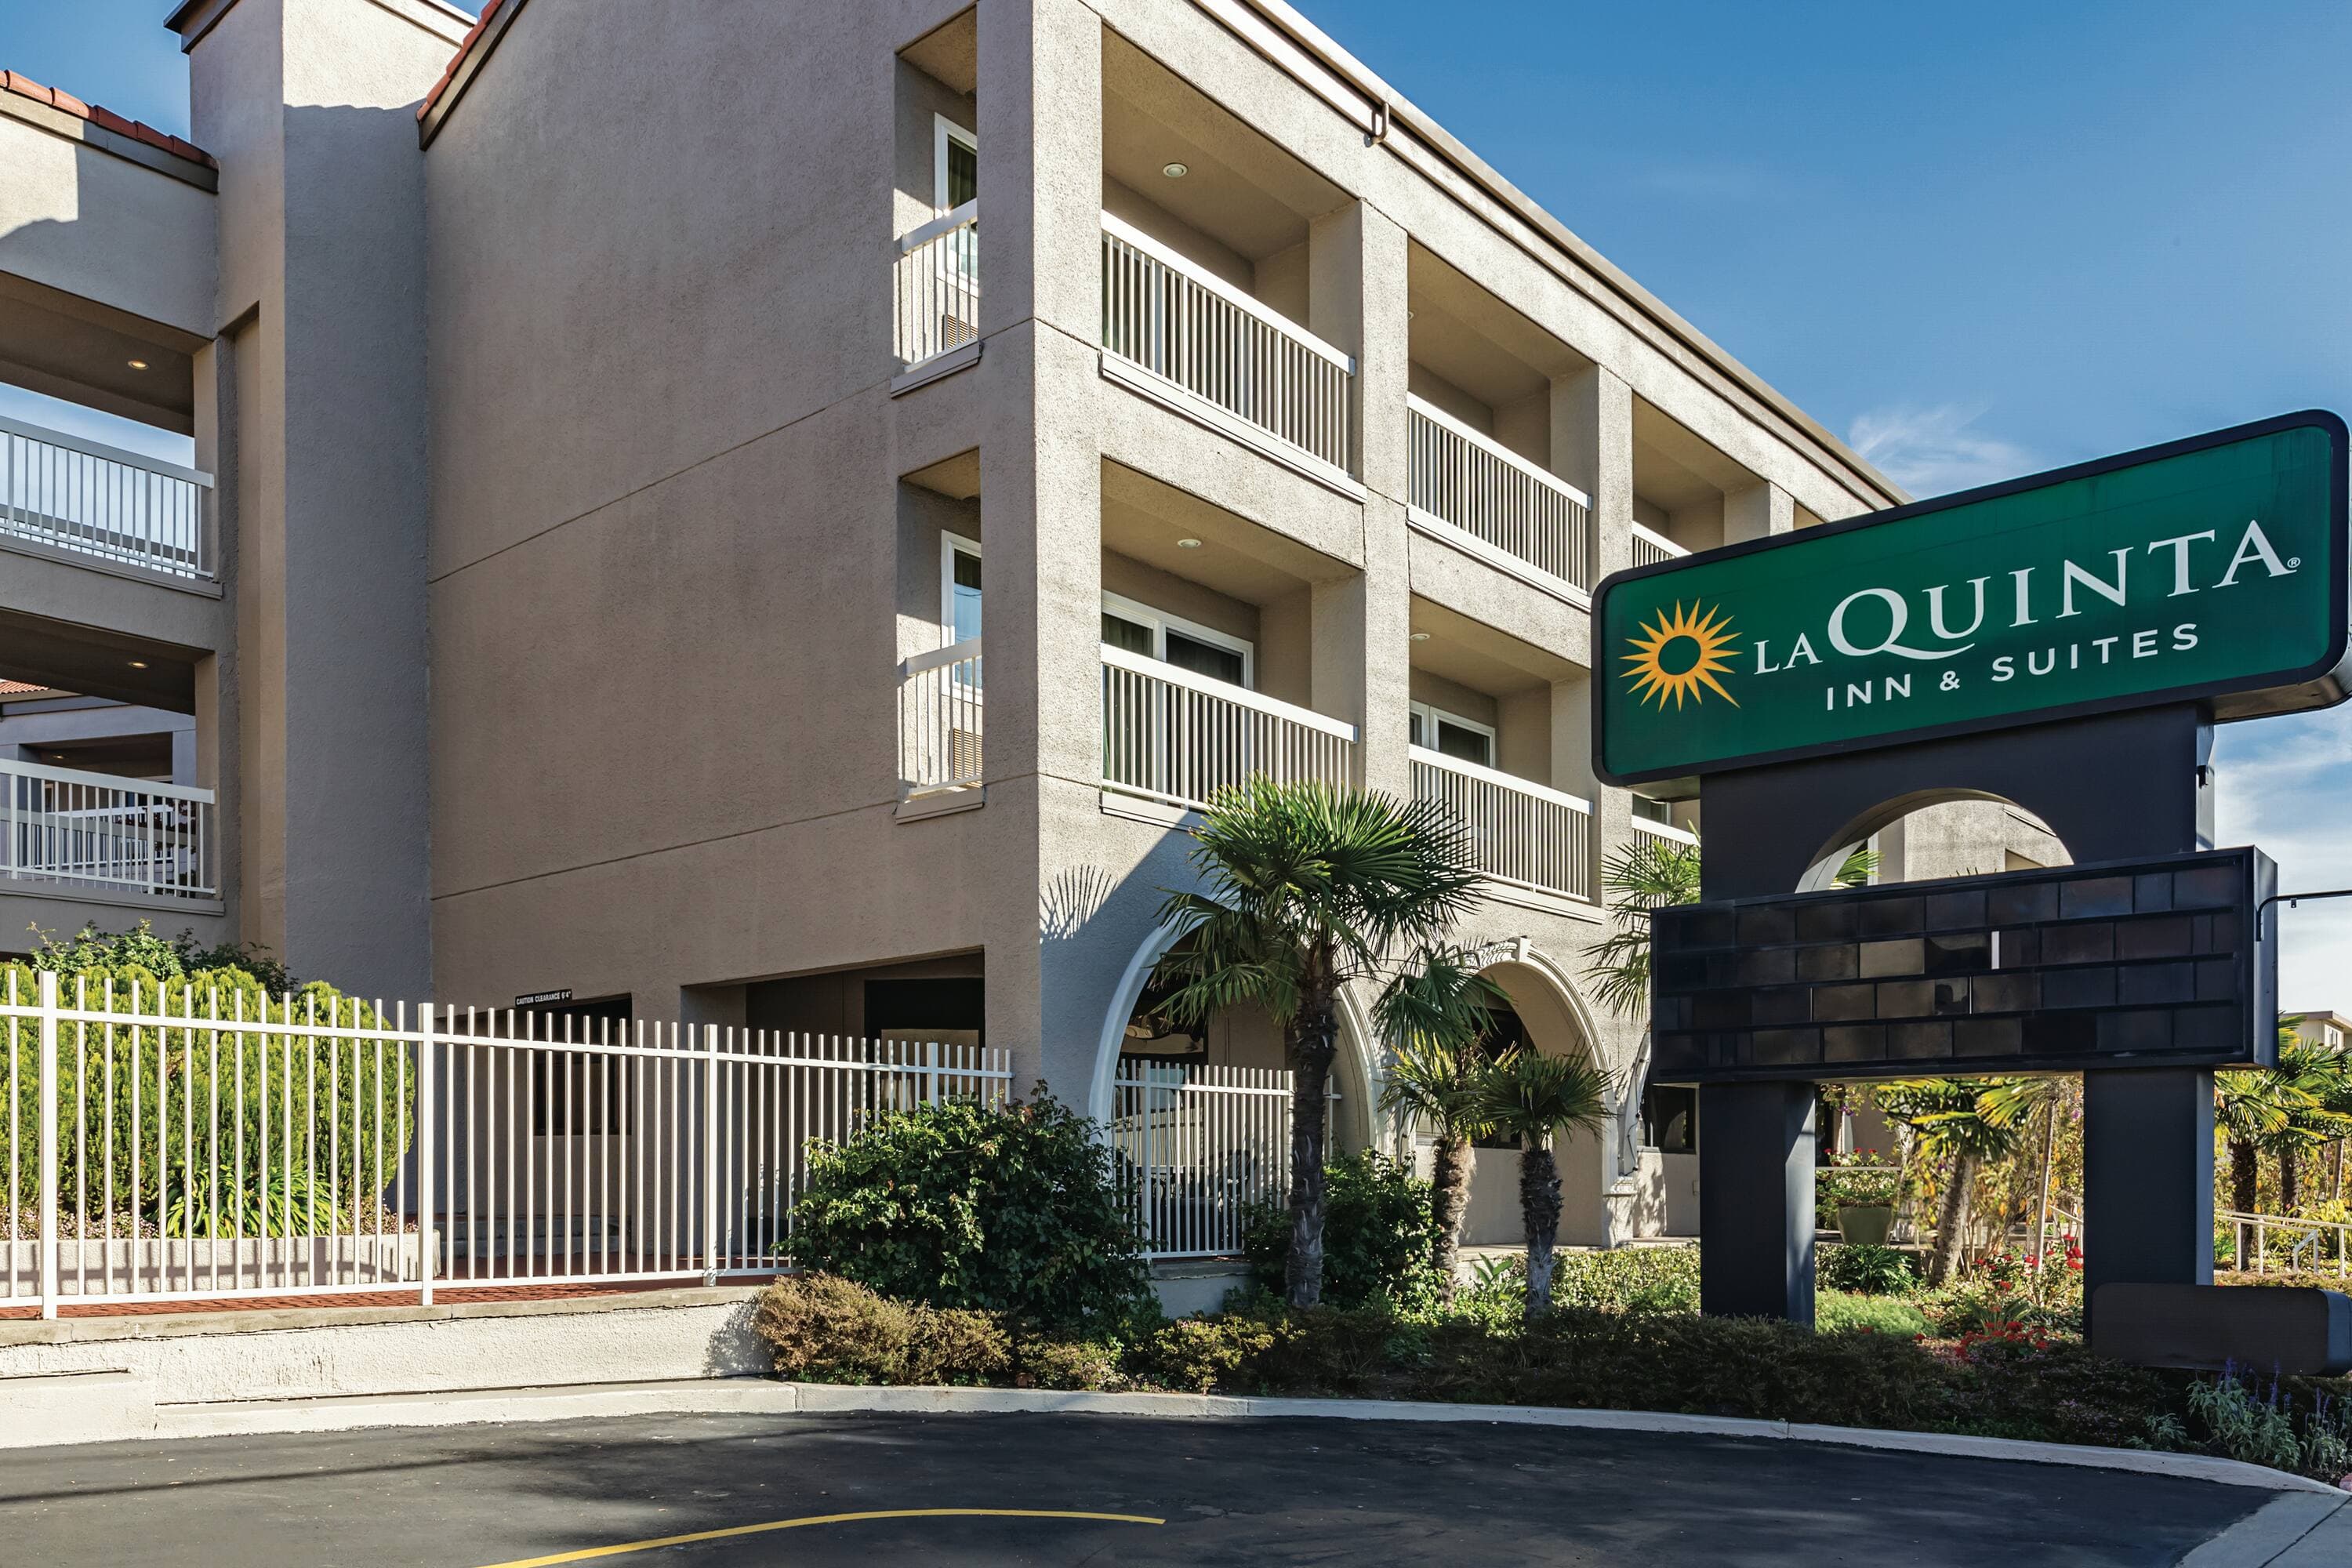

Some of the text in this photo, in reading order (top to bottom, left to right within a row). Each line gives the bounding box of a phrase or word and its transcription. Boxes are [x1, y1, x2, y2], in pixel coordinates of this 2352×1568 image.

[1754, 519, 2298, 675] LA QUINTA
[1827, 623, 2199, 711] INN & SUITES
[517, 996, 534, 1005] CAUTION
[535, 992, 560, 1002] CLEARANCE
